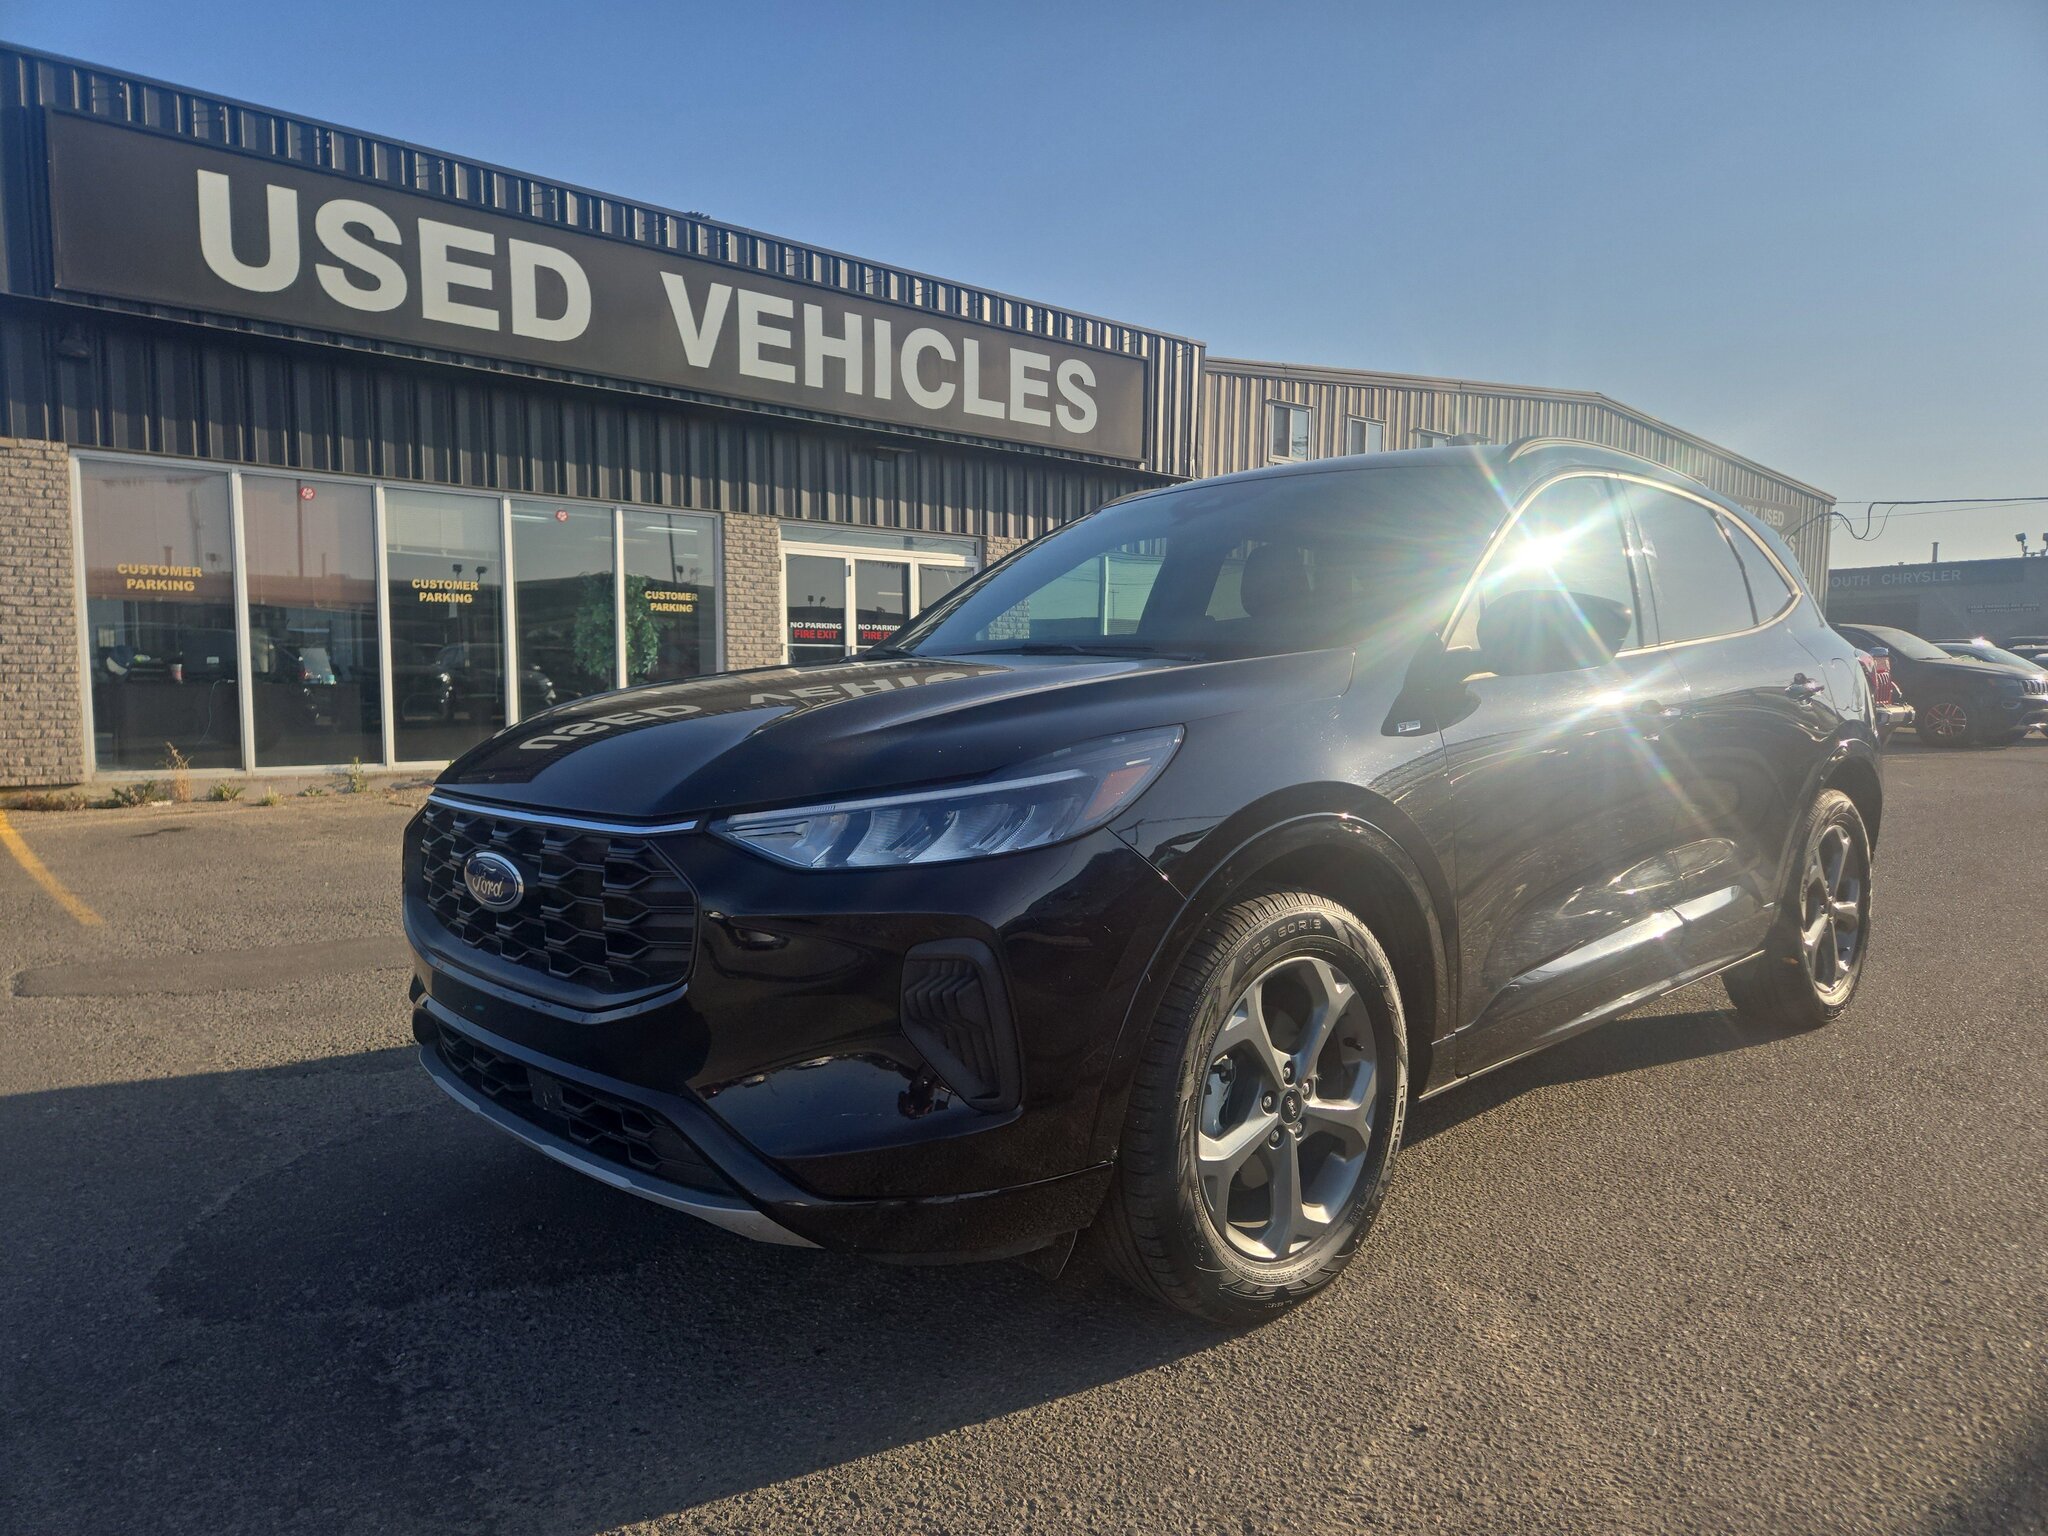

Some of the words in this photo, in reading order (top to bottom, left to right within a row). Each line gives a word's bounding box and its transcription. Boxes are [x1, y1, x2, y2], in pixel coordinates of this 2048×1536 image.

[197, 169, 592, 341] USED
[659, 271, 1098, 434] VEHICLES
[117, 563, 202, 577] CUSTOMER
[1881, 569, 1961, 585] CHRYSLER
[126, 578, 195, 591] PARKING
[411, 579, 479, 591] CUSTOMER
[419, 592, 473, 603] PARKING
[644, 591, 698, 601] CUSTOMER
[650, 603, 693, 612] PARKING
[794, 629, 815, 638] FIRE
[817, 630, 837, 639] EXIT
[862, 631, 882, 639] FIRE
[472, 863, 505, 898] Ford
